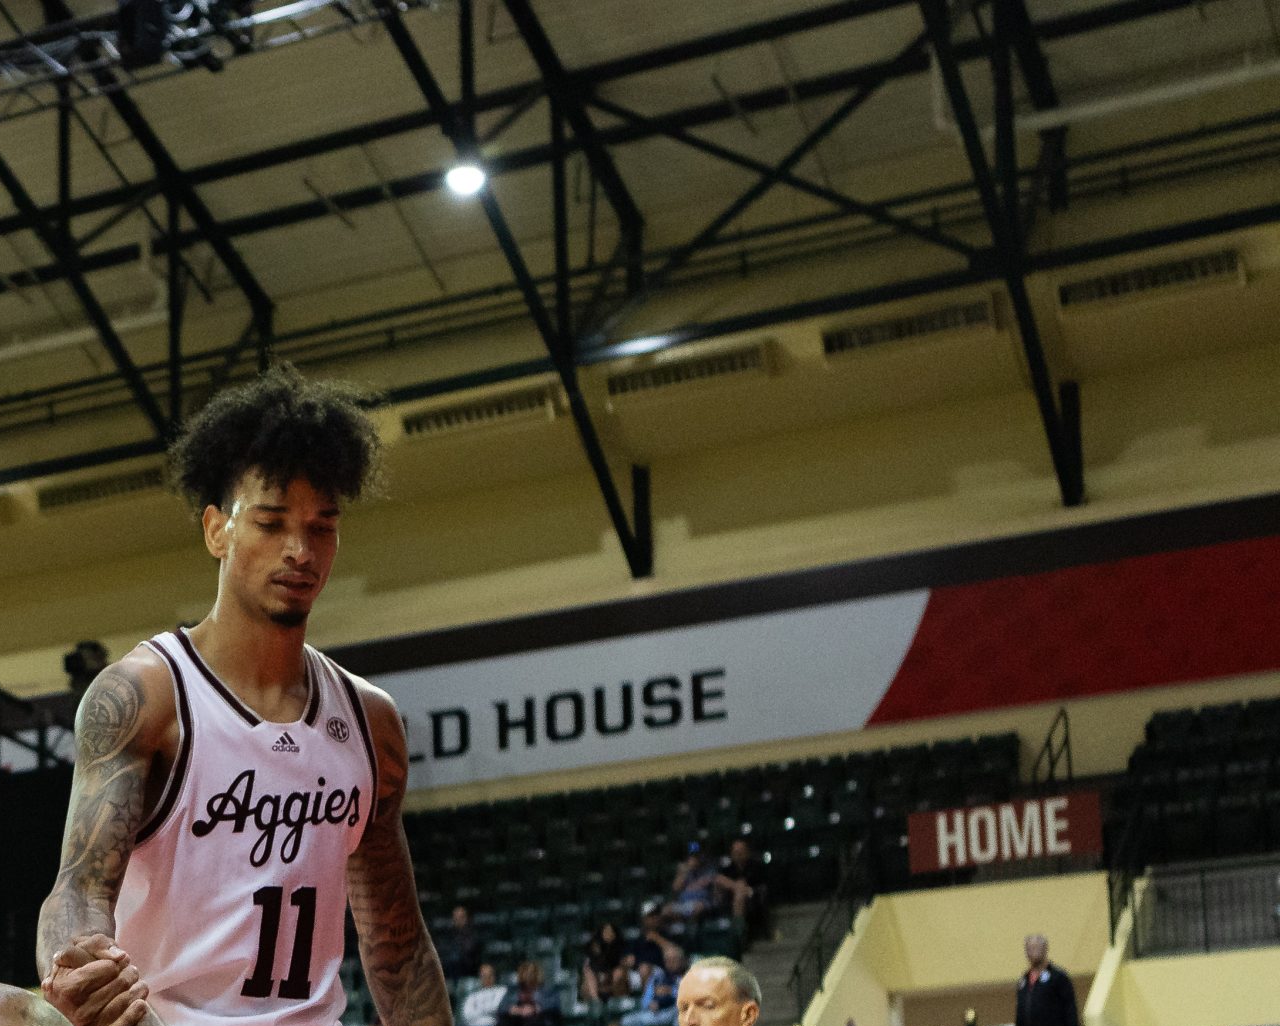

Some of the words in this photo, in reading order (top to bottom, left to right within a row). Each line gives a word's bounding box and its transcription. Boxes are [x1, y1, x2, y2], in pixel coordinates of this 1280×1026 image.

[271, 743, 300, 753] adidas
[328, 719, 348, 741] SEC
[402, 708, 470, 763] D
[495, 668, 729, 751] HOUSE
[191, 769, 361, 868] Aggies
[935, 796, 1072, 870] HOME
[240, 886, 317, 1000] 11
